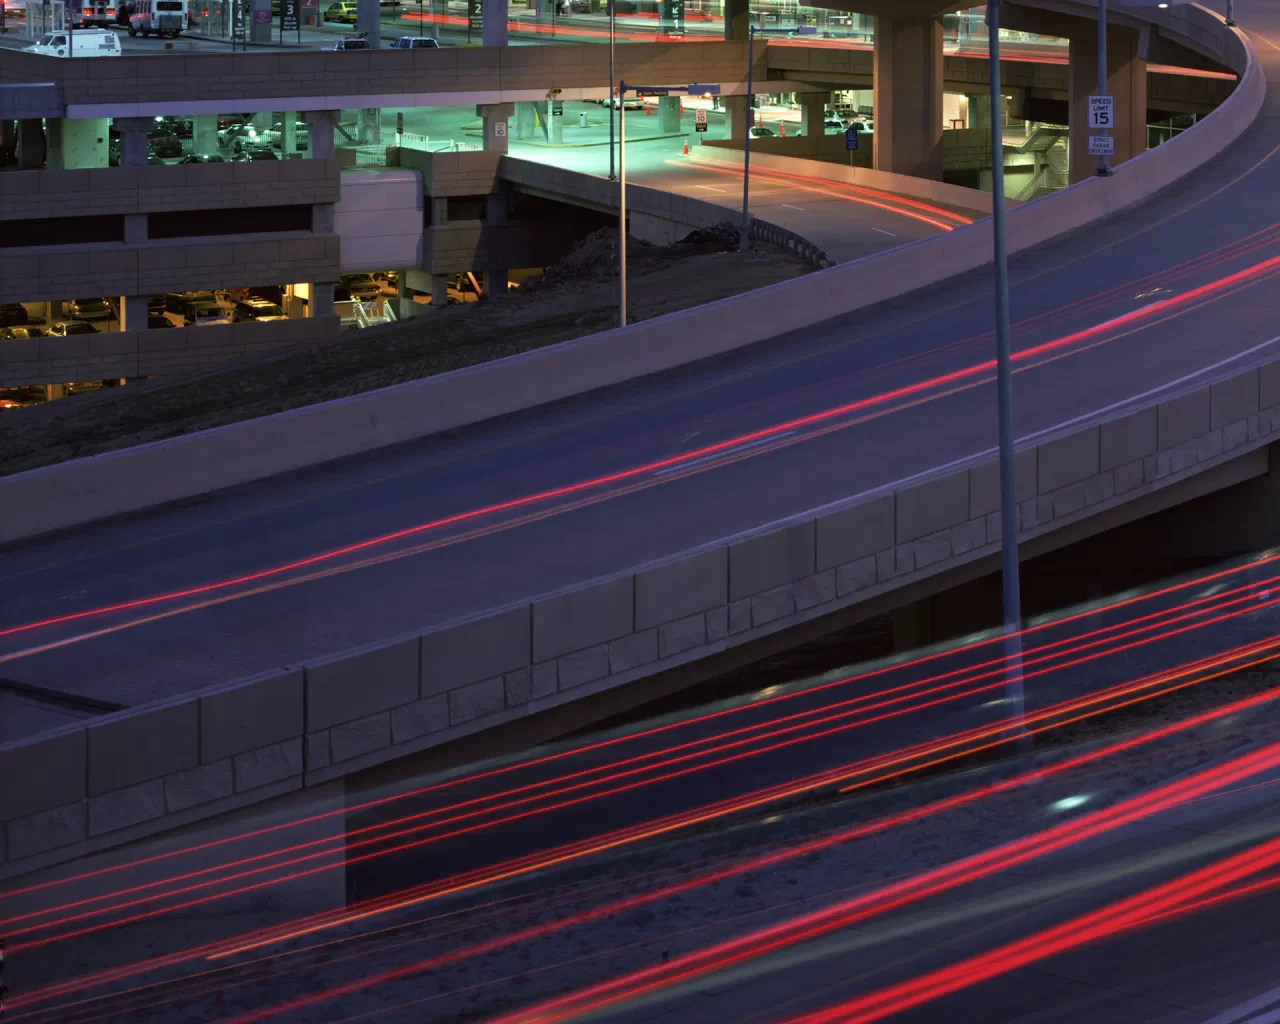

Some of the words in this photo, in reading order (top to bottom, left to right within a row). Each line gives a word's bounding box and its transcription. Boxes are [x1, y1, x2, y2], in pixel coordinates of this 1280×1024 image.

[286, 5, 294, 14] 3
[475, 4, 482, 14] 2
[238, 10, 242, 20] 4
[674, 20, 678, 28] 1
[1094, 112, 1109, 124] 15
